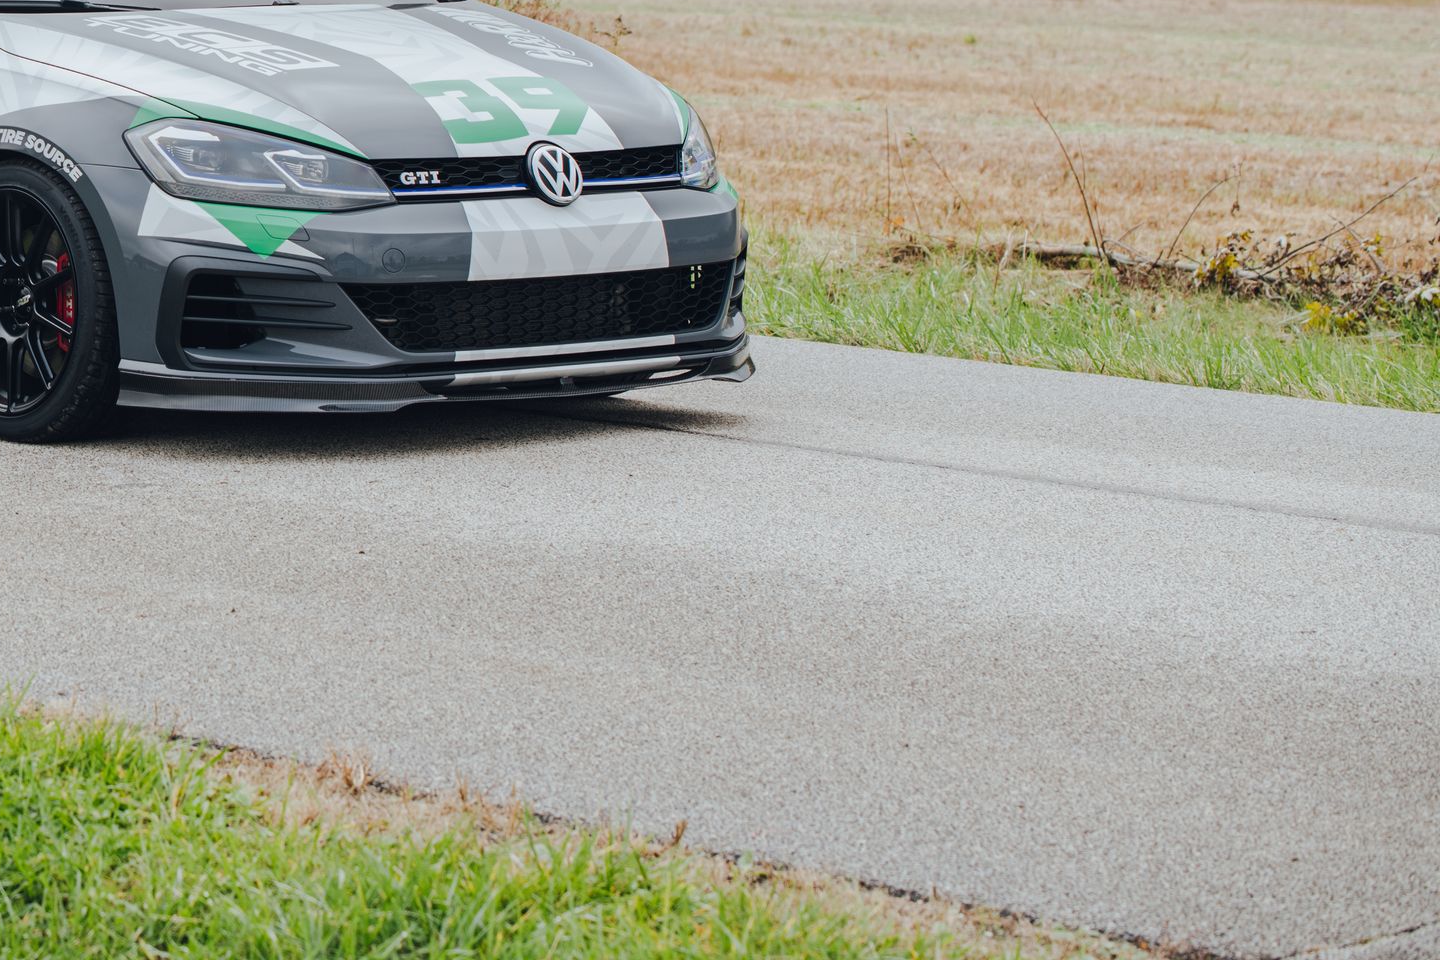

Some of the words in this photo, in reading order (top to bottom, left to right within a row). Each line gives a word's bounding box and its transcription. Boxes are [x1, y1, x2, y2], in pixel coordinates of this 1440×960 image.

[84, 19, 284, 76] TUNING
[411, 76, 589, 144] 39
[25, 135, 83, 182] SOURCE
[400, 171, 440, 185] GTI
